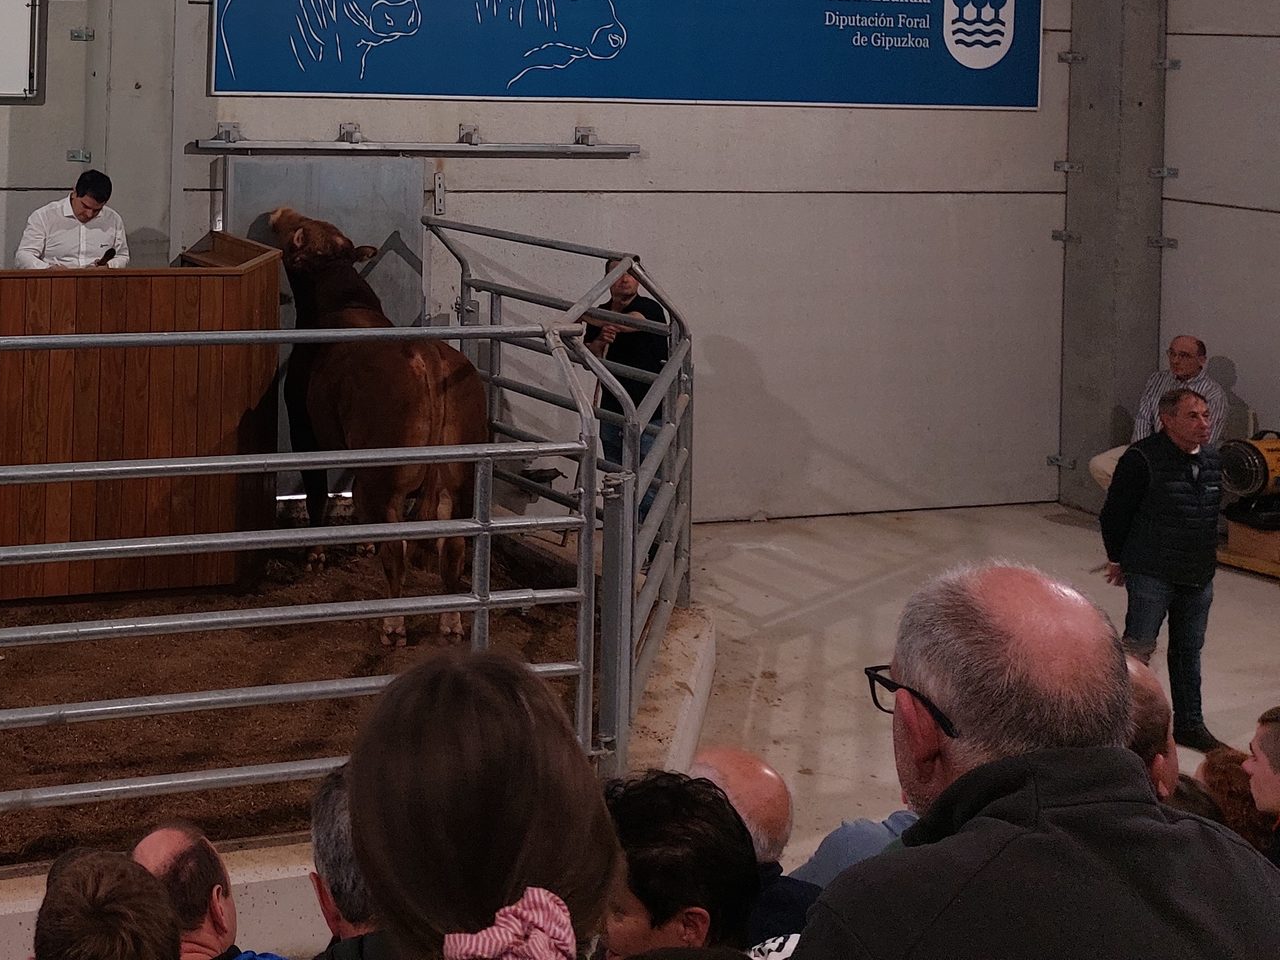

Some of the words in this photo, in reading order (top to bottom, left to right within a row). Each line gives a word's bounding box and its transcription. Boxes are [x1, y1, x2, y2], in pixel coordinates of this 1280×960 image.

[825, 11, 894, 29] Diputación
[898, 14, 930, 28] Foral
[852, 32, 868, 46] de
[871, 33, 930, 50] Gipuzkoa
